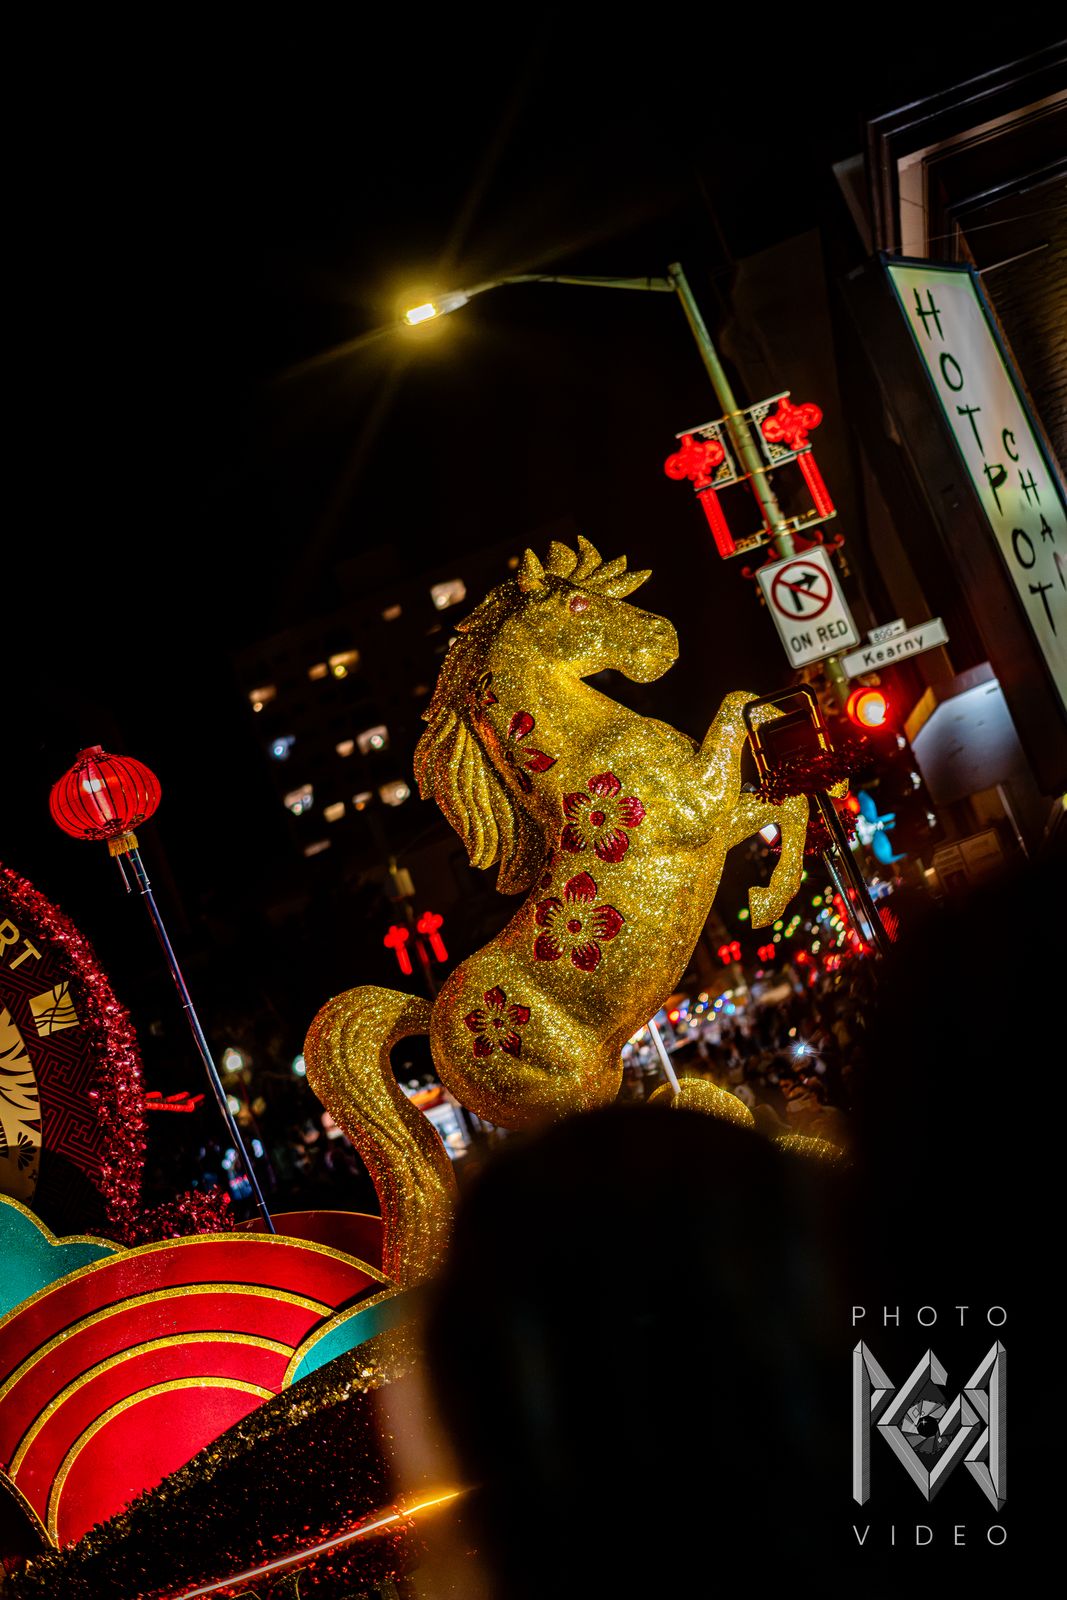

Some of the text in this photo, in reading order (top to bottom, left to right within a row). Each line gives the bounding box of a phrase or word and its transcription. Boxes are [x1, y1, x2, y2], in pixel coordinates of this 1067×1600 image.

[790, 619, 849, 653] ON RED
[862, 634, 924, 667] Kearny
